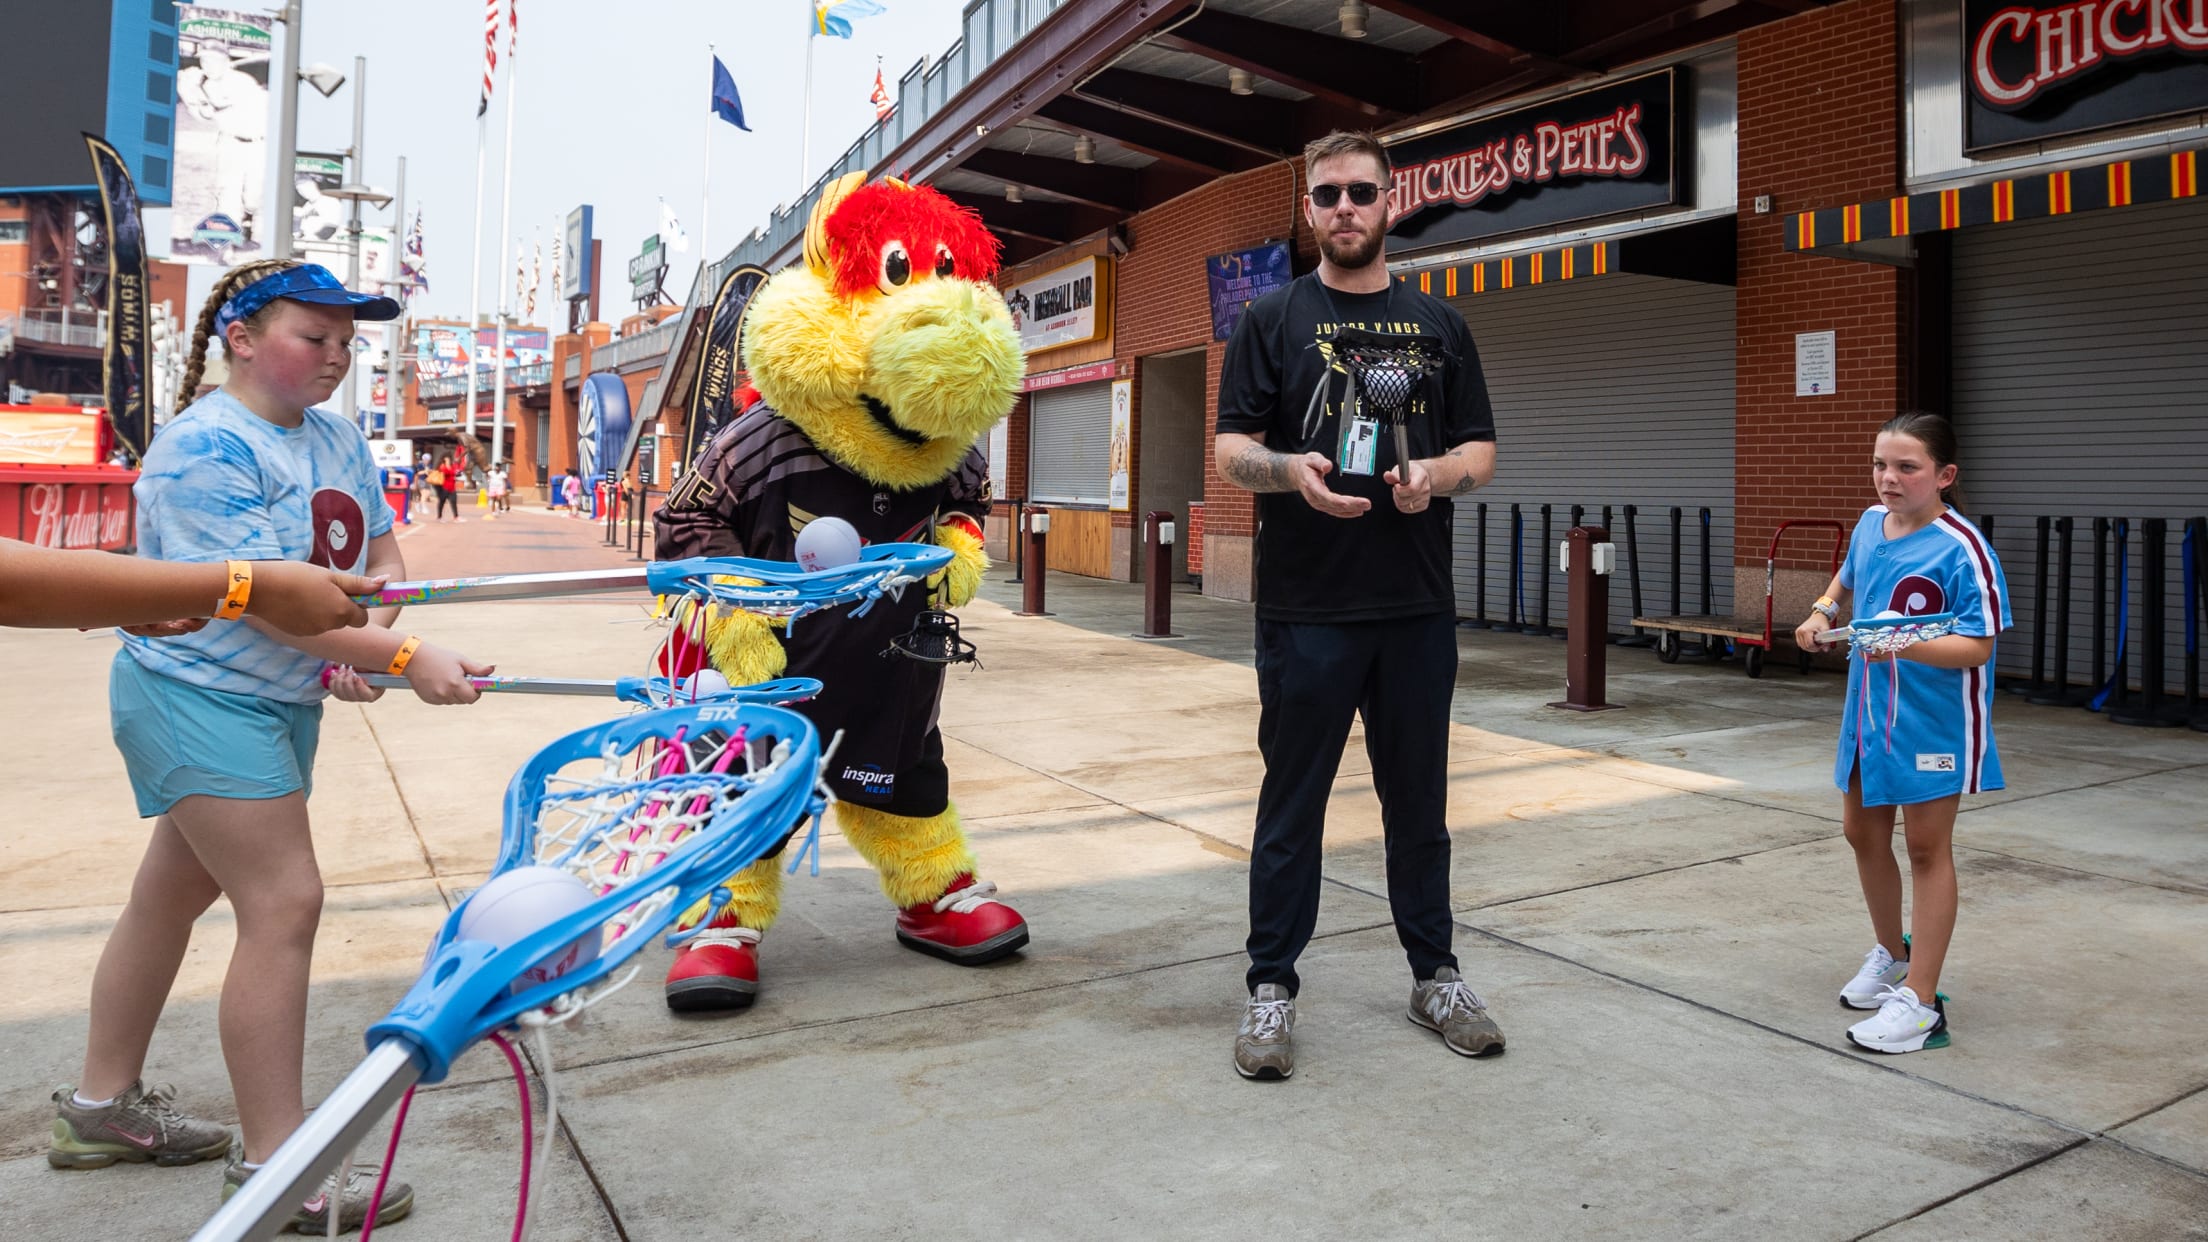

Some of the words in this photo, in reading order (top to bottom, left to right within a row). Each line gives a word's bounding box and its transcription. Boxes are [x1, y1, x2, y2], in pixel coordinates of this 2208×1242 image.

[186, 23, 240, 39] ASHBURN
[1389, 140, 1509, 219] HICKIE'S
[1511, 138, 1533, 177] &
[1536, 107, 1643, 177] PETE'S
[1073, 276, 1092, 310] BAR
[1221, 287, 1257, 303] PHILADELPHIA
[1226, 276, 1252, 291] WELCOME
[1253, 274, 1260, 287] TO
[1262, 272, 1273, 285] THE
[120, 273, 137, 341] WINGS
[708, 345, 728, 399] WINGS
[30, 484, 129, 549] Budweiser
[696, 706, 739, 721] STX
[842, 766, 895, 786] inspira
